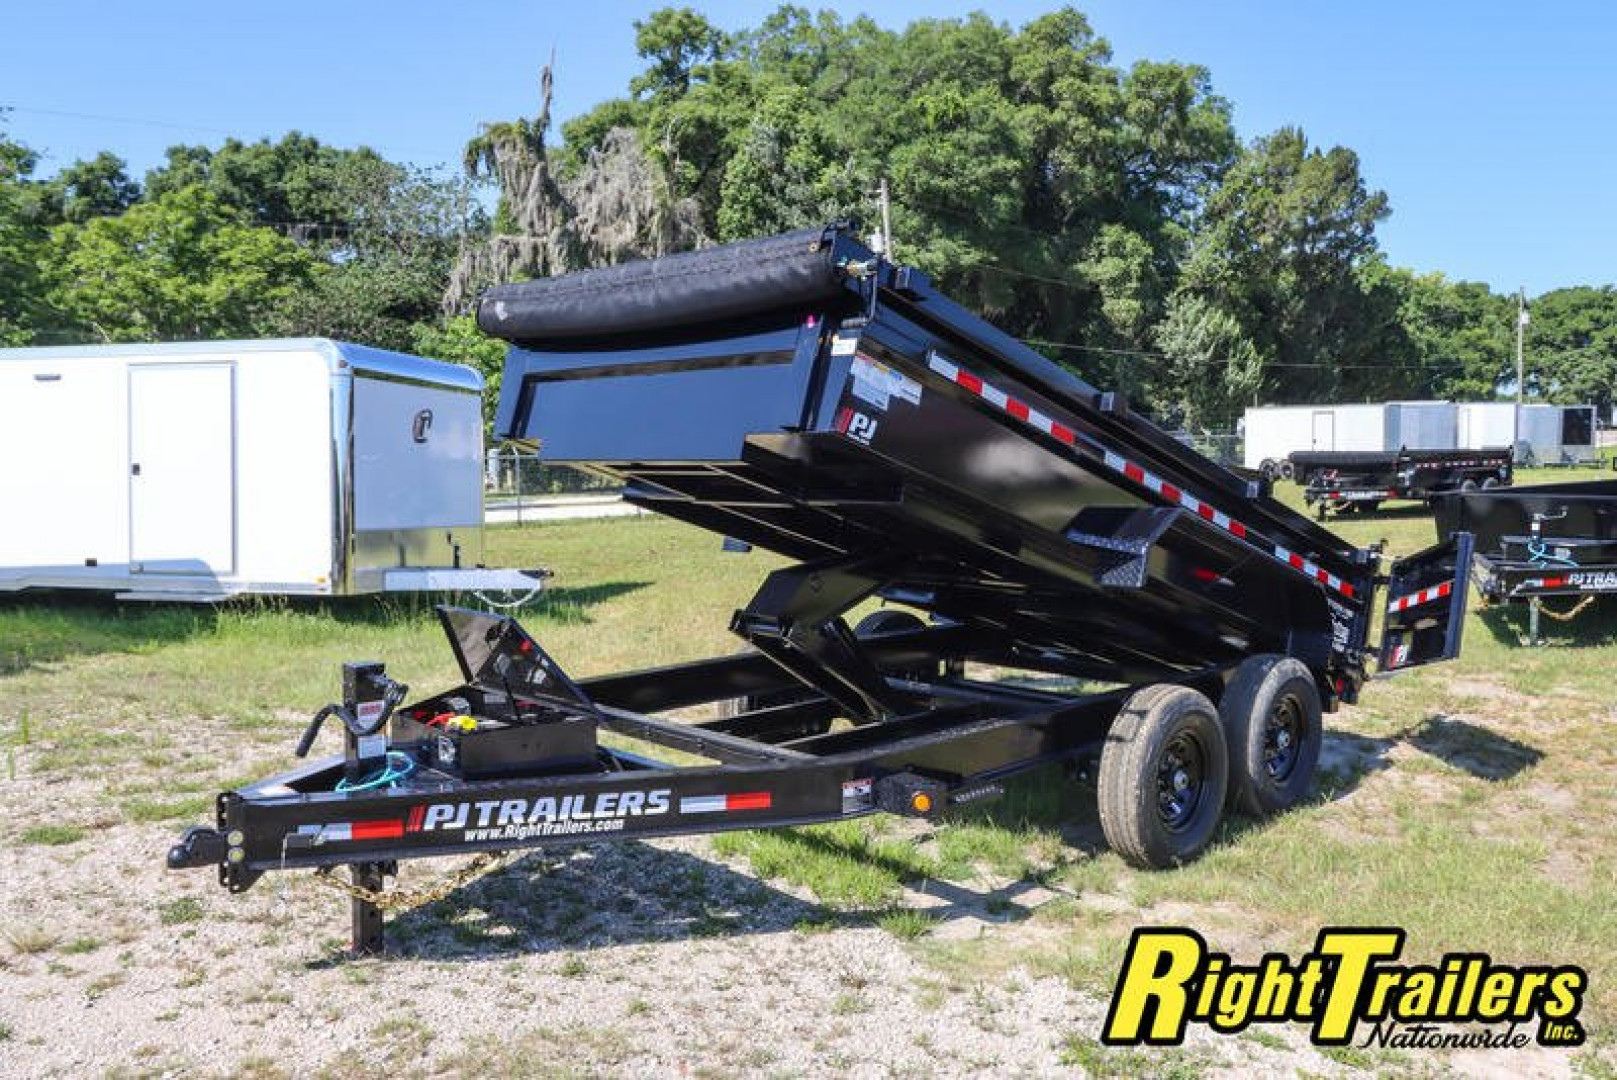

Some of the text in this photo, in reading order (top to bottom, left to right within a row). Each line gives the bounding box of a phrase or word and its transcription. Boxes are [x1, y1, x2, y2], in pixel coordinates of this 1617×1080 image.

[848, 412, 878, 439] PJ
[474, 789, 672, 828] TRAILERS
[464, 818, 625, 842] www.RightTrailers.com
